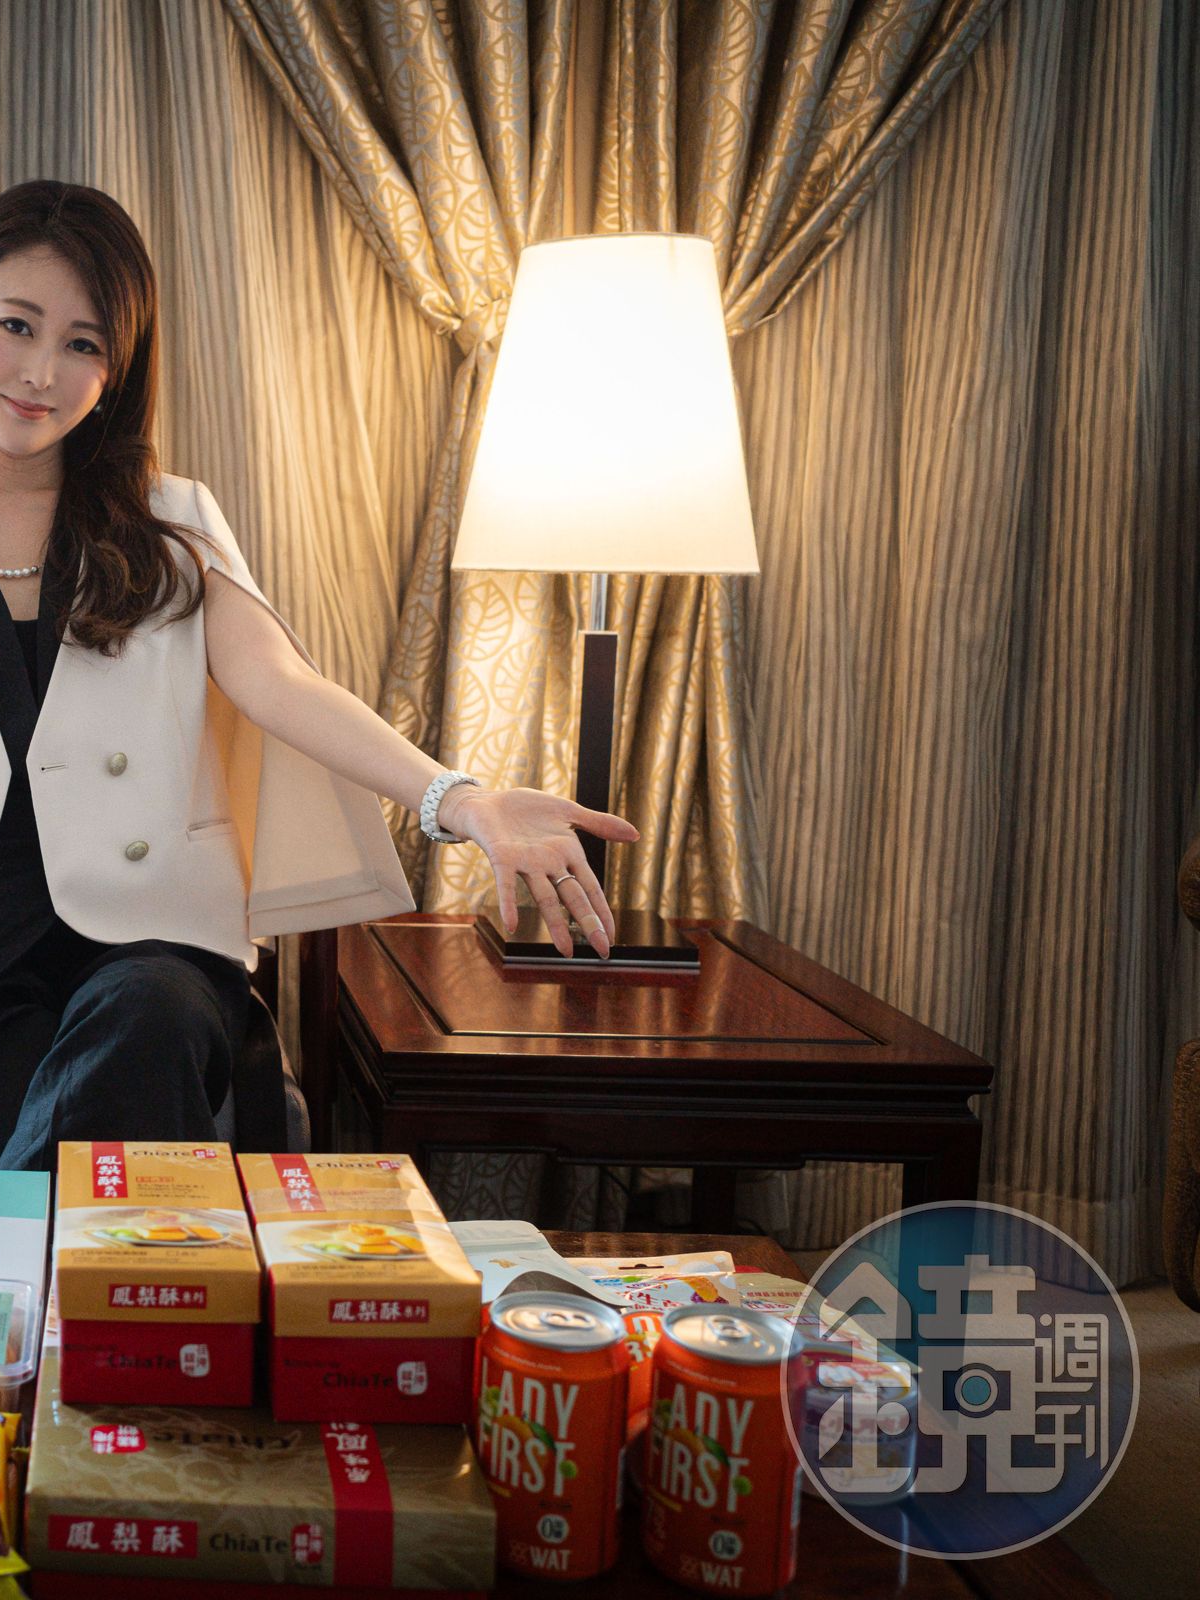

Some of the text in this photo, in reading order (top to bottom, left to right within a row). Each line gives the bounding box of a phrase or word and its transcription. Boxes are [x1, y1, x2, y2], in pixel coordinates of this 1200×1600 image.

[478, 1413, 577, 1498] FIRST
[65, 1520, 185, 1553] 鳳梨酥
[209, 1533, 288, 1552] ChiaTe
